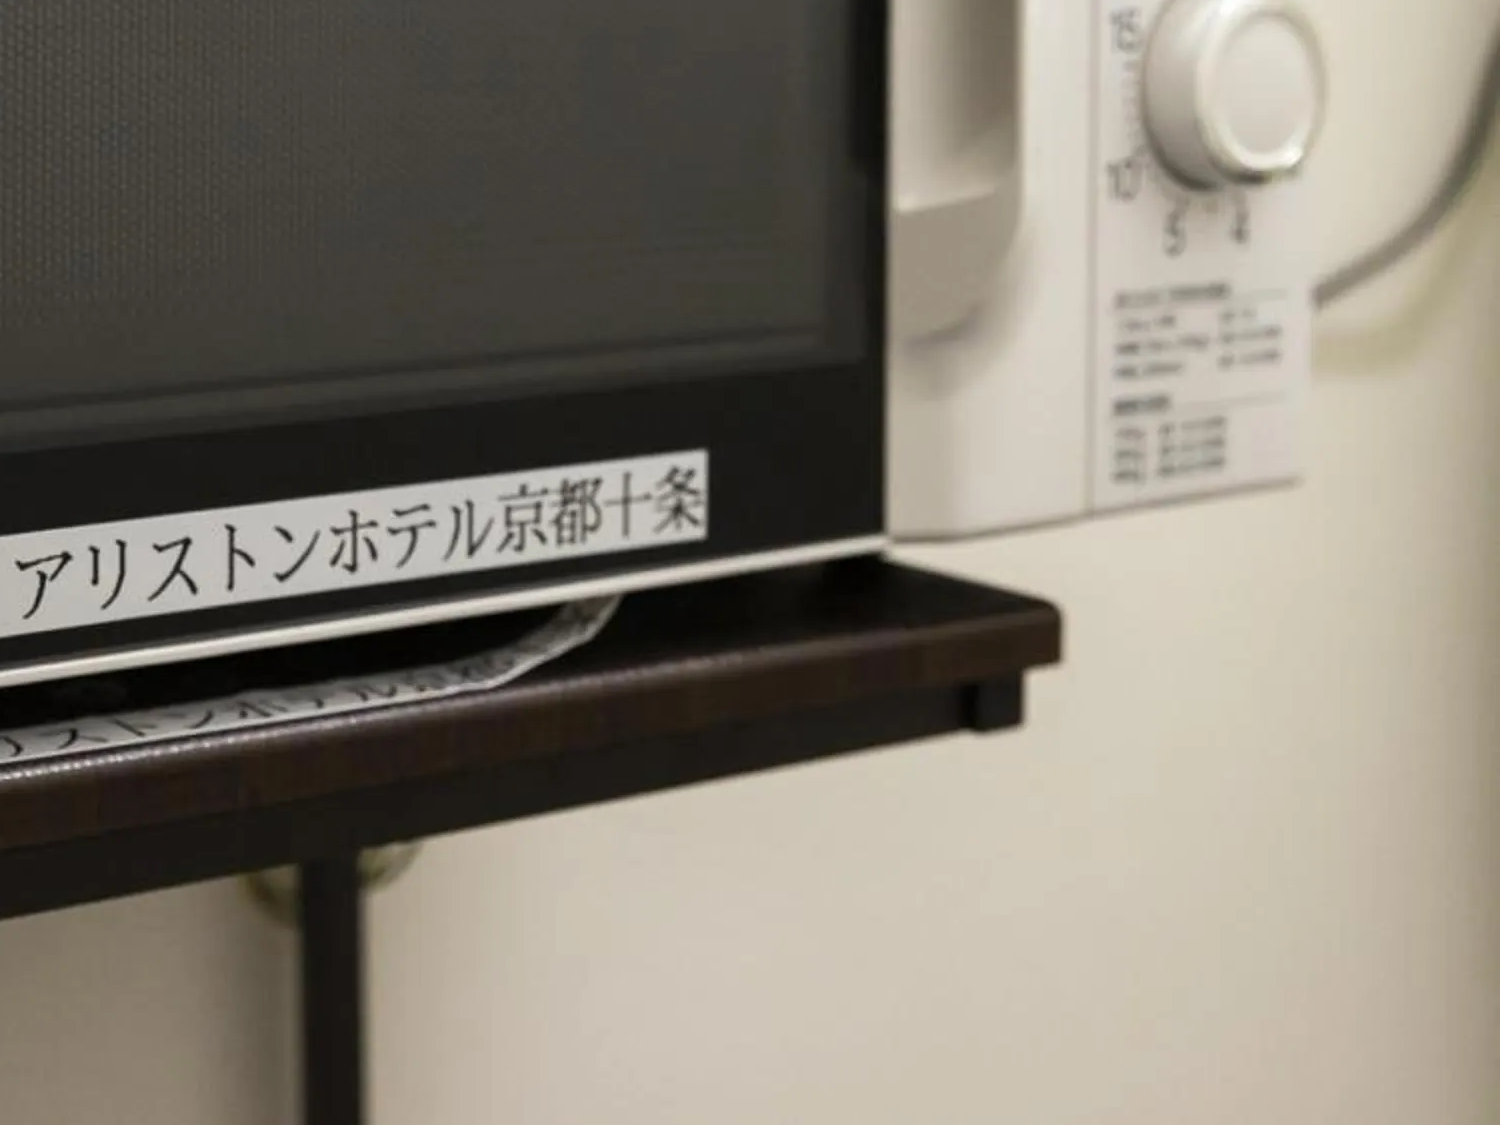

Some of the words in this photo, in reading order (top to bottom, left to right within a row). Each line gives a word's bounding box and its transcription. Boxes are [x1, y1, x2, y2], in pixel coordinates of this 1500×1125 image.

[14, 467, 705, 621] アリストンホテル京都十条
